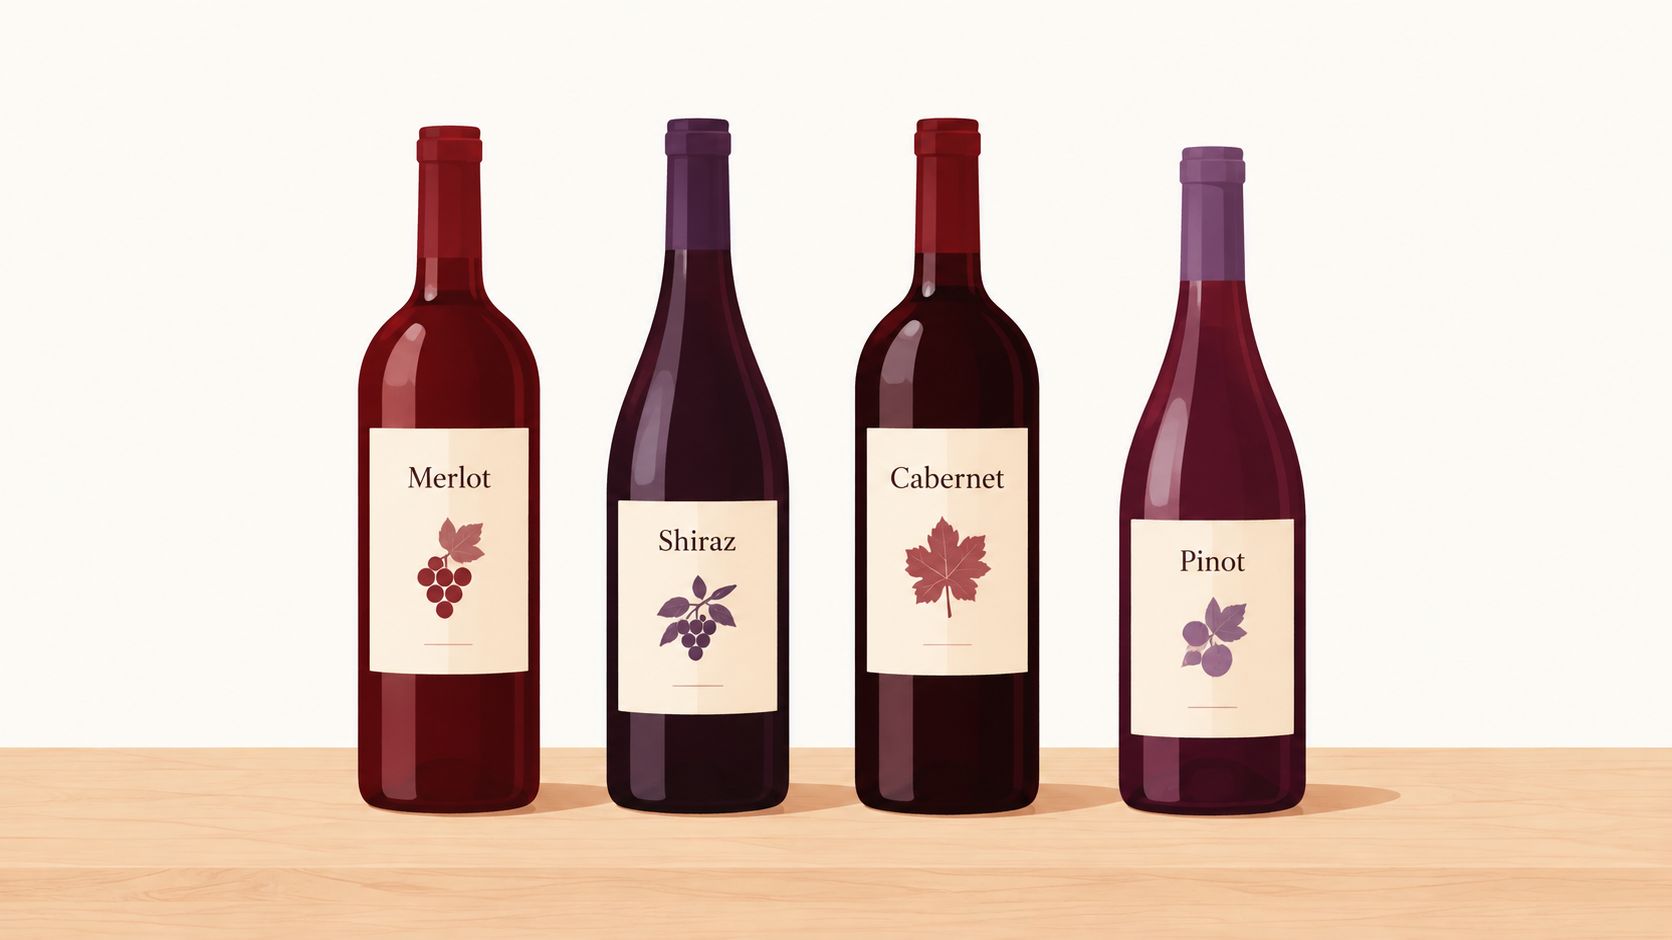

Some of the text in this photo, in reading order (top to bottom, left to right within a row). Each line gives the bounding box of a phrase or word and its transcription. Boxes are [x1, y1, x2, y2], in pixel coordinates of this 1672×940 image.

[408, 465, 491, 489] Merlot
[890, 465, 1005, 489] Cabernet
[658, 528, 737, 552] Shiraz
[1180, 549, 1246, 572] Pinot
